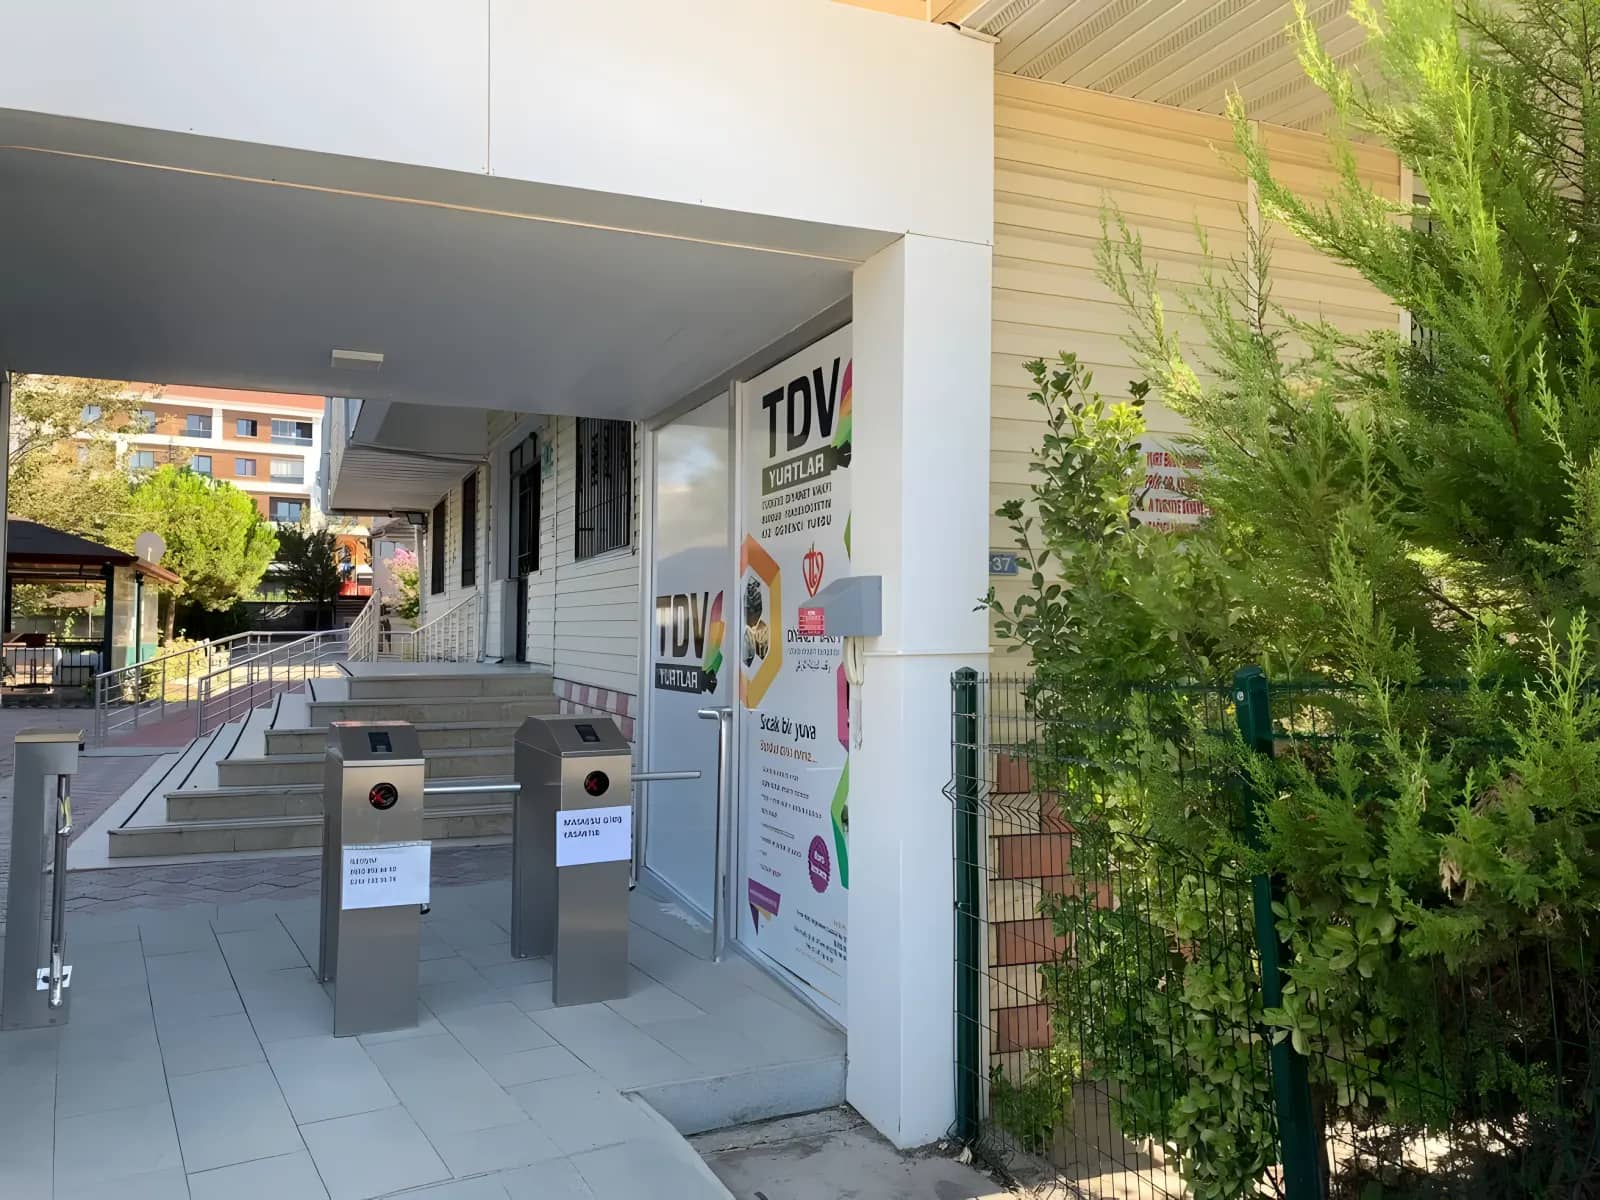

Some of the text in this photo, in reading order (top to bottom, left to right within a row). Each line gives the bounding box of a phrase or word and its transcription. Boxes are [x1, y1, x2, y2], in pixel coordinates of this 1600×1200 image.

[762, 357, 840, 458] TDV
[769, 453, 824, 488] YURTLAR
[656, 591, 709, 659] TDV
[659, 669, 698, 689] YURTLAR
